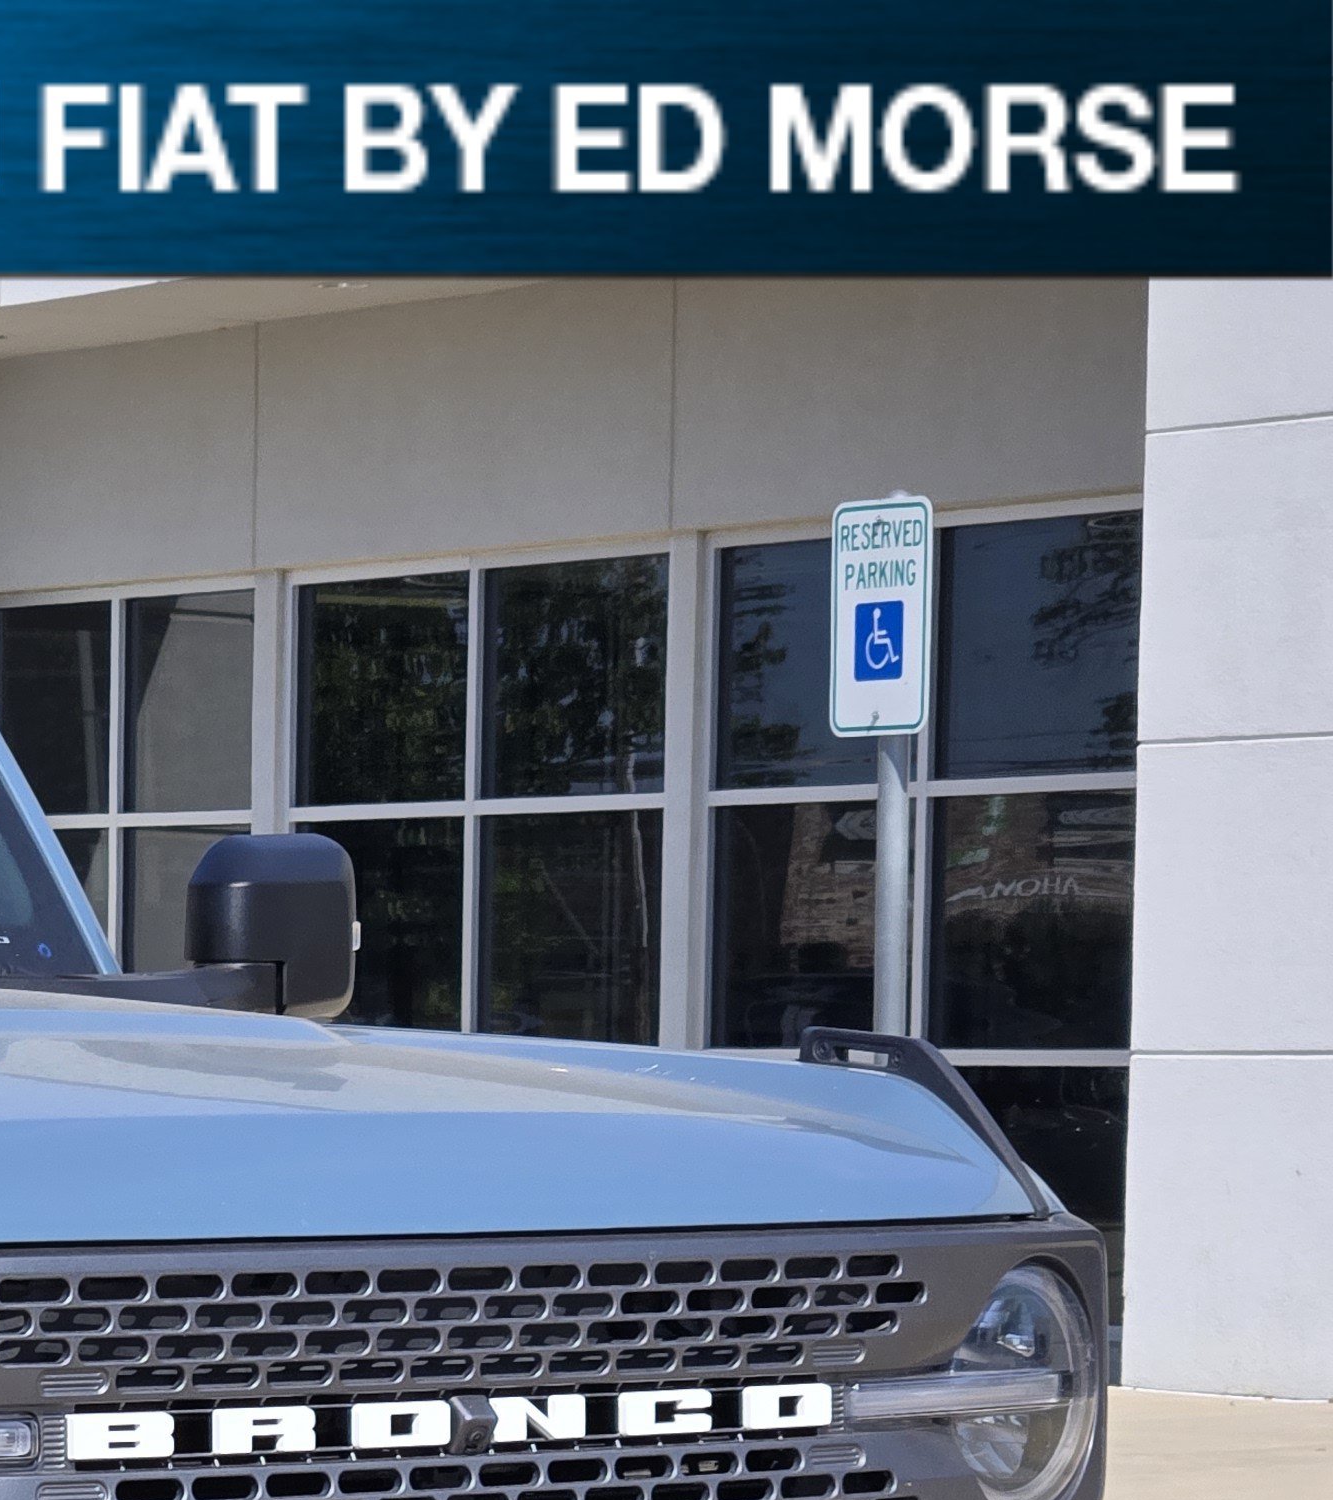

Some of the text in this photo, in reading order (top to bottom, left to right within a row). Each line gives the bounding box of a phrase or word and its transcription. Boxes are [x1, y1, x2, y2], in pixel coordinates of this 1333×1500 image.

[840, 519, 923, 552] RESERVED
[844, 559, 916, 590] PARKING
[65, 1382, 833, 1461] BRONCO
